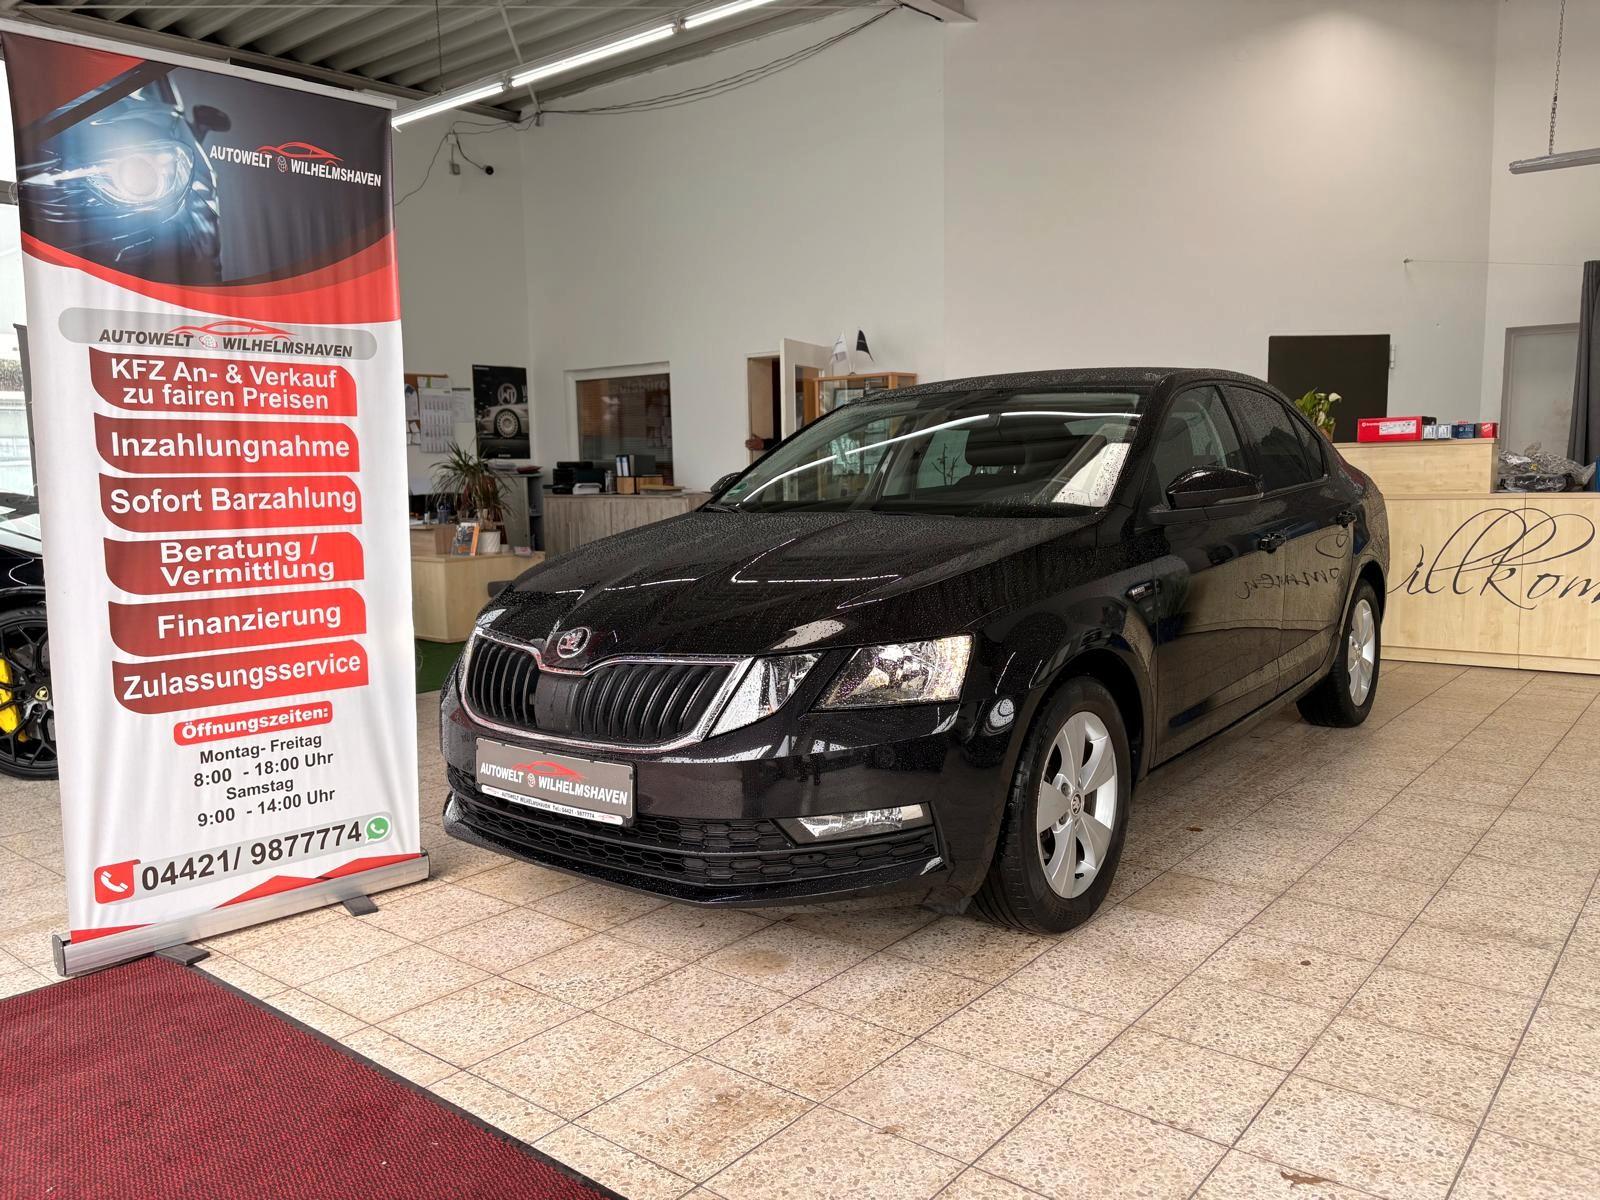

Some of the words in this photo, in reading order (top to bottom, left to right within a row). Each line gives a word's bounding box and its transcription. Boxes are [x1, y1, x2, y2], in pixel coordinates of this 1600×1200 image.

[210, 145, 272, 168] AUTOWELT
[291, 159, 382, 187] WILHELMSHAVEN
[99, 329, 194, 347] AUTOWELT
[223, 337, 353, 357] WILHELMSHAVEN
[111, 358, 166, 381] KFZ
[173, 361, 218, 383] An-
[225, 364, 243, 384] &
[249, 365, 337, 389] Verkauf
[123, 387, 154, 404] zu
[162, 384, 235, 407] fairen
[243, 387, 329, 410] Preisen
[111, 432, 350, 463] Inzahlungnahme
[110, 488, 202, 514] Sofort
[211, 487, 357, 513] Barzahlung
[160, 539, 302, 564] Beratung
[309, 535, 318, 555] /
[160, 559, 335, 587] Vermittlung
[157, 605, 342, 640] Finanzierung
[123, 653, 361, 701] Zulassungsservice
[181, 706, 329, 740] Öffnungszeiten:
[199, 742, 266, 765] Montag-
[270, 734, 323, 752] Freitag
[193, 767, 233, 788] 8:00
[254, 756, 300, 776] 18:00
[304, 751, 334, 768] Uhr
[480, 762, 524, 784] AUTOWELT
[538, 775, 628, 805] WILHELMSHAVEN
[225, 777, 295, 801] Samstag
[501, 791, 519, 802] AUTOWELT
[197, 807, 236, 827] 9:00
[256, 794, 302, 816] 14:00
[306, 788, 336, 805] Uhr
[141, 846, 242, 892] 04421/
[251, 820, 362, 866] 9877774
